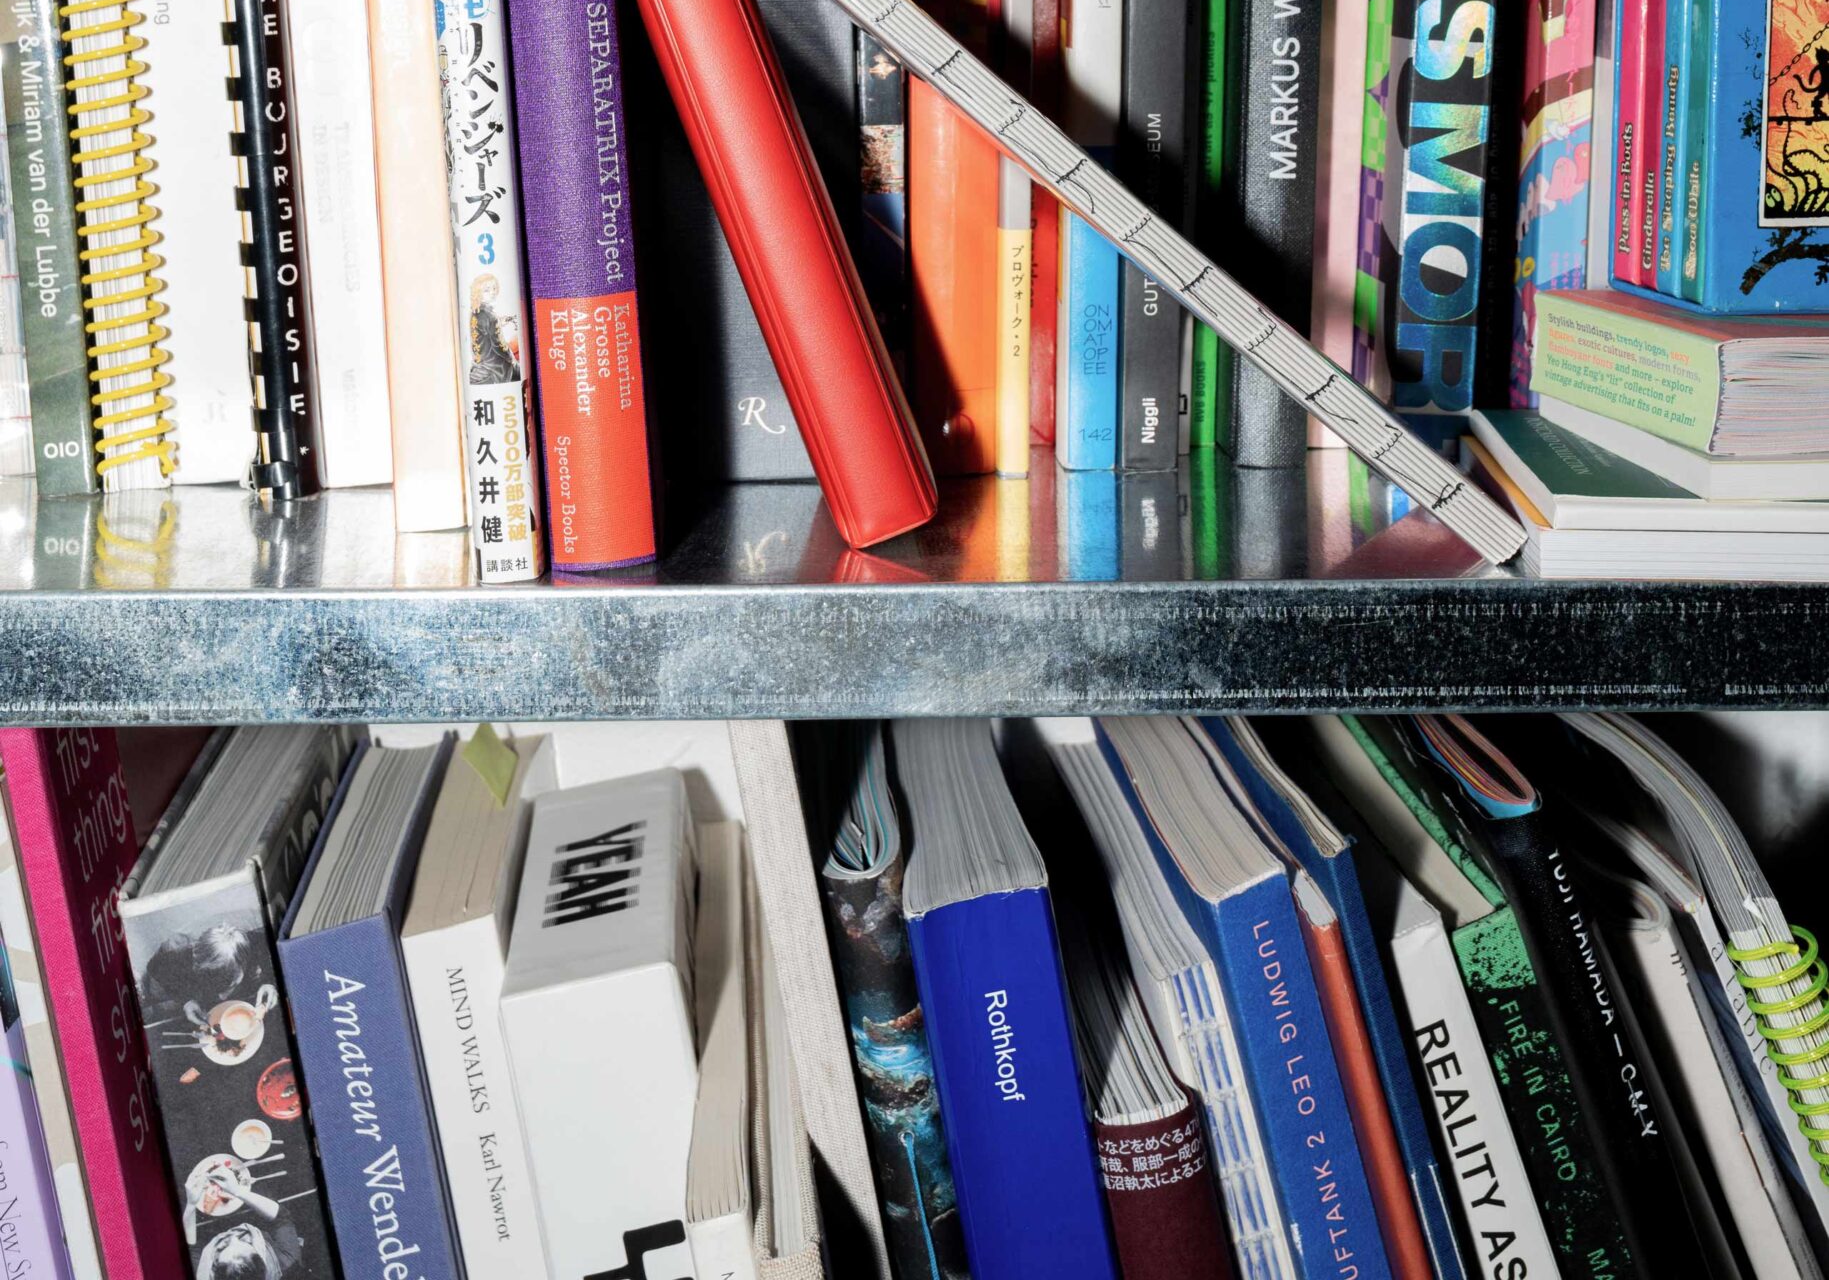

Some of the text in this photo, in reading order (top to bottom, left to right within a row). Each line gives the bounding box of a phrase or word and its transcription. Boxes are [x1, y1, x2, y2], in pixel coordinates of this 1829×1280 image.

[20, 34, 36, 54] &
[20, 62, 45, 144] Miriam
[584, 2, 620, 185] SEPARATRIX
[1269, 36, 1300, 181] MARKUS
[1666, 64, 1680, 138] Beauty
[29, 148, 48, 191] van
[1619, 122, 1633, 255] Puss-in-Boots
[1662, 142, 1676, 233] Sleeping
[1688, 160, 1700, 222] White
[32, 197, 52, 237] der
[477, 233, 496, 265] 3
[599, 191, 624, 284] Project
[1642, 167, 1655, 270] Cinderella
[35, 245, 59, 318] Lubbe
[1083, 303, 1110, 318] ON
[549, 309, 567, 372] Kluge
[594, 305, 612, 379] Grosse
[613, 303, 633, 411] Katharina
[1083, 318, 1113, 333] OM
[1083, 332, 1107, 347] AT
[1083, 346, 1109, 361] OP
[1547, 312, 1576, 329] Stylish
[1576, 320, 1616, 343] buildings,
[1616, 333, 1644, 352] trendy
[1645, 341, 1670, 360] logos,
[1578, 336, 1601, 351] exotic
[1603, 342, 1638, 362] cultures,
[1639, 355, 1671, 373] modern
[570, 309, 592, 416] Alexander
[1083, 361, 1107, 376] EE
[1544, 369, 1697, 429] vintage advertising that fits on palm!
[1546, 353, 1678, 406] Yeo Hong Eng's collection of
[1615, 362, 1631, 375] and
[1631, 368, 1653, 382] more
[1661, 375, 1694, 395] explore
[739, 396, 786, 435] R
[1079, 427, 1113, 441] 142
[1140, 396, 1159, 444] Niggli
[474, 399, 504, 544] 和久井健
[502, 395, 528, 542] 3500万部突破
[556, 436, 577, 555] Spector Books
[486, 558, 529, 574] 講談社
[541, 819, 648, 929] YEAH
[1569, 911, 1616, 1027] HAMADA
[984, 988, 1026, 1102] Rothkopf
[1252, 920, 1316, 1115] LUDWIG LEO
[324, 969, 383, 1142] Amateur
[1500, 999, 1577, 1182] FIRE IN CAIRO
[445, 966, 511, 1243] MIND WALKS Karl Nawrot
[1306, 1130, 1326, 1148] 2
[1415, 1018, 1507, 1209] REALITY
